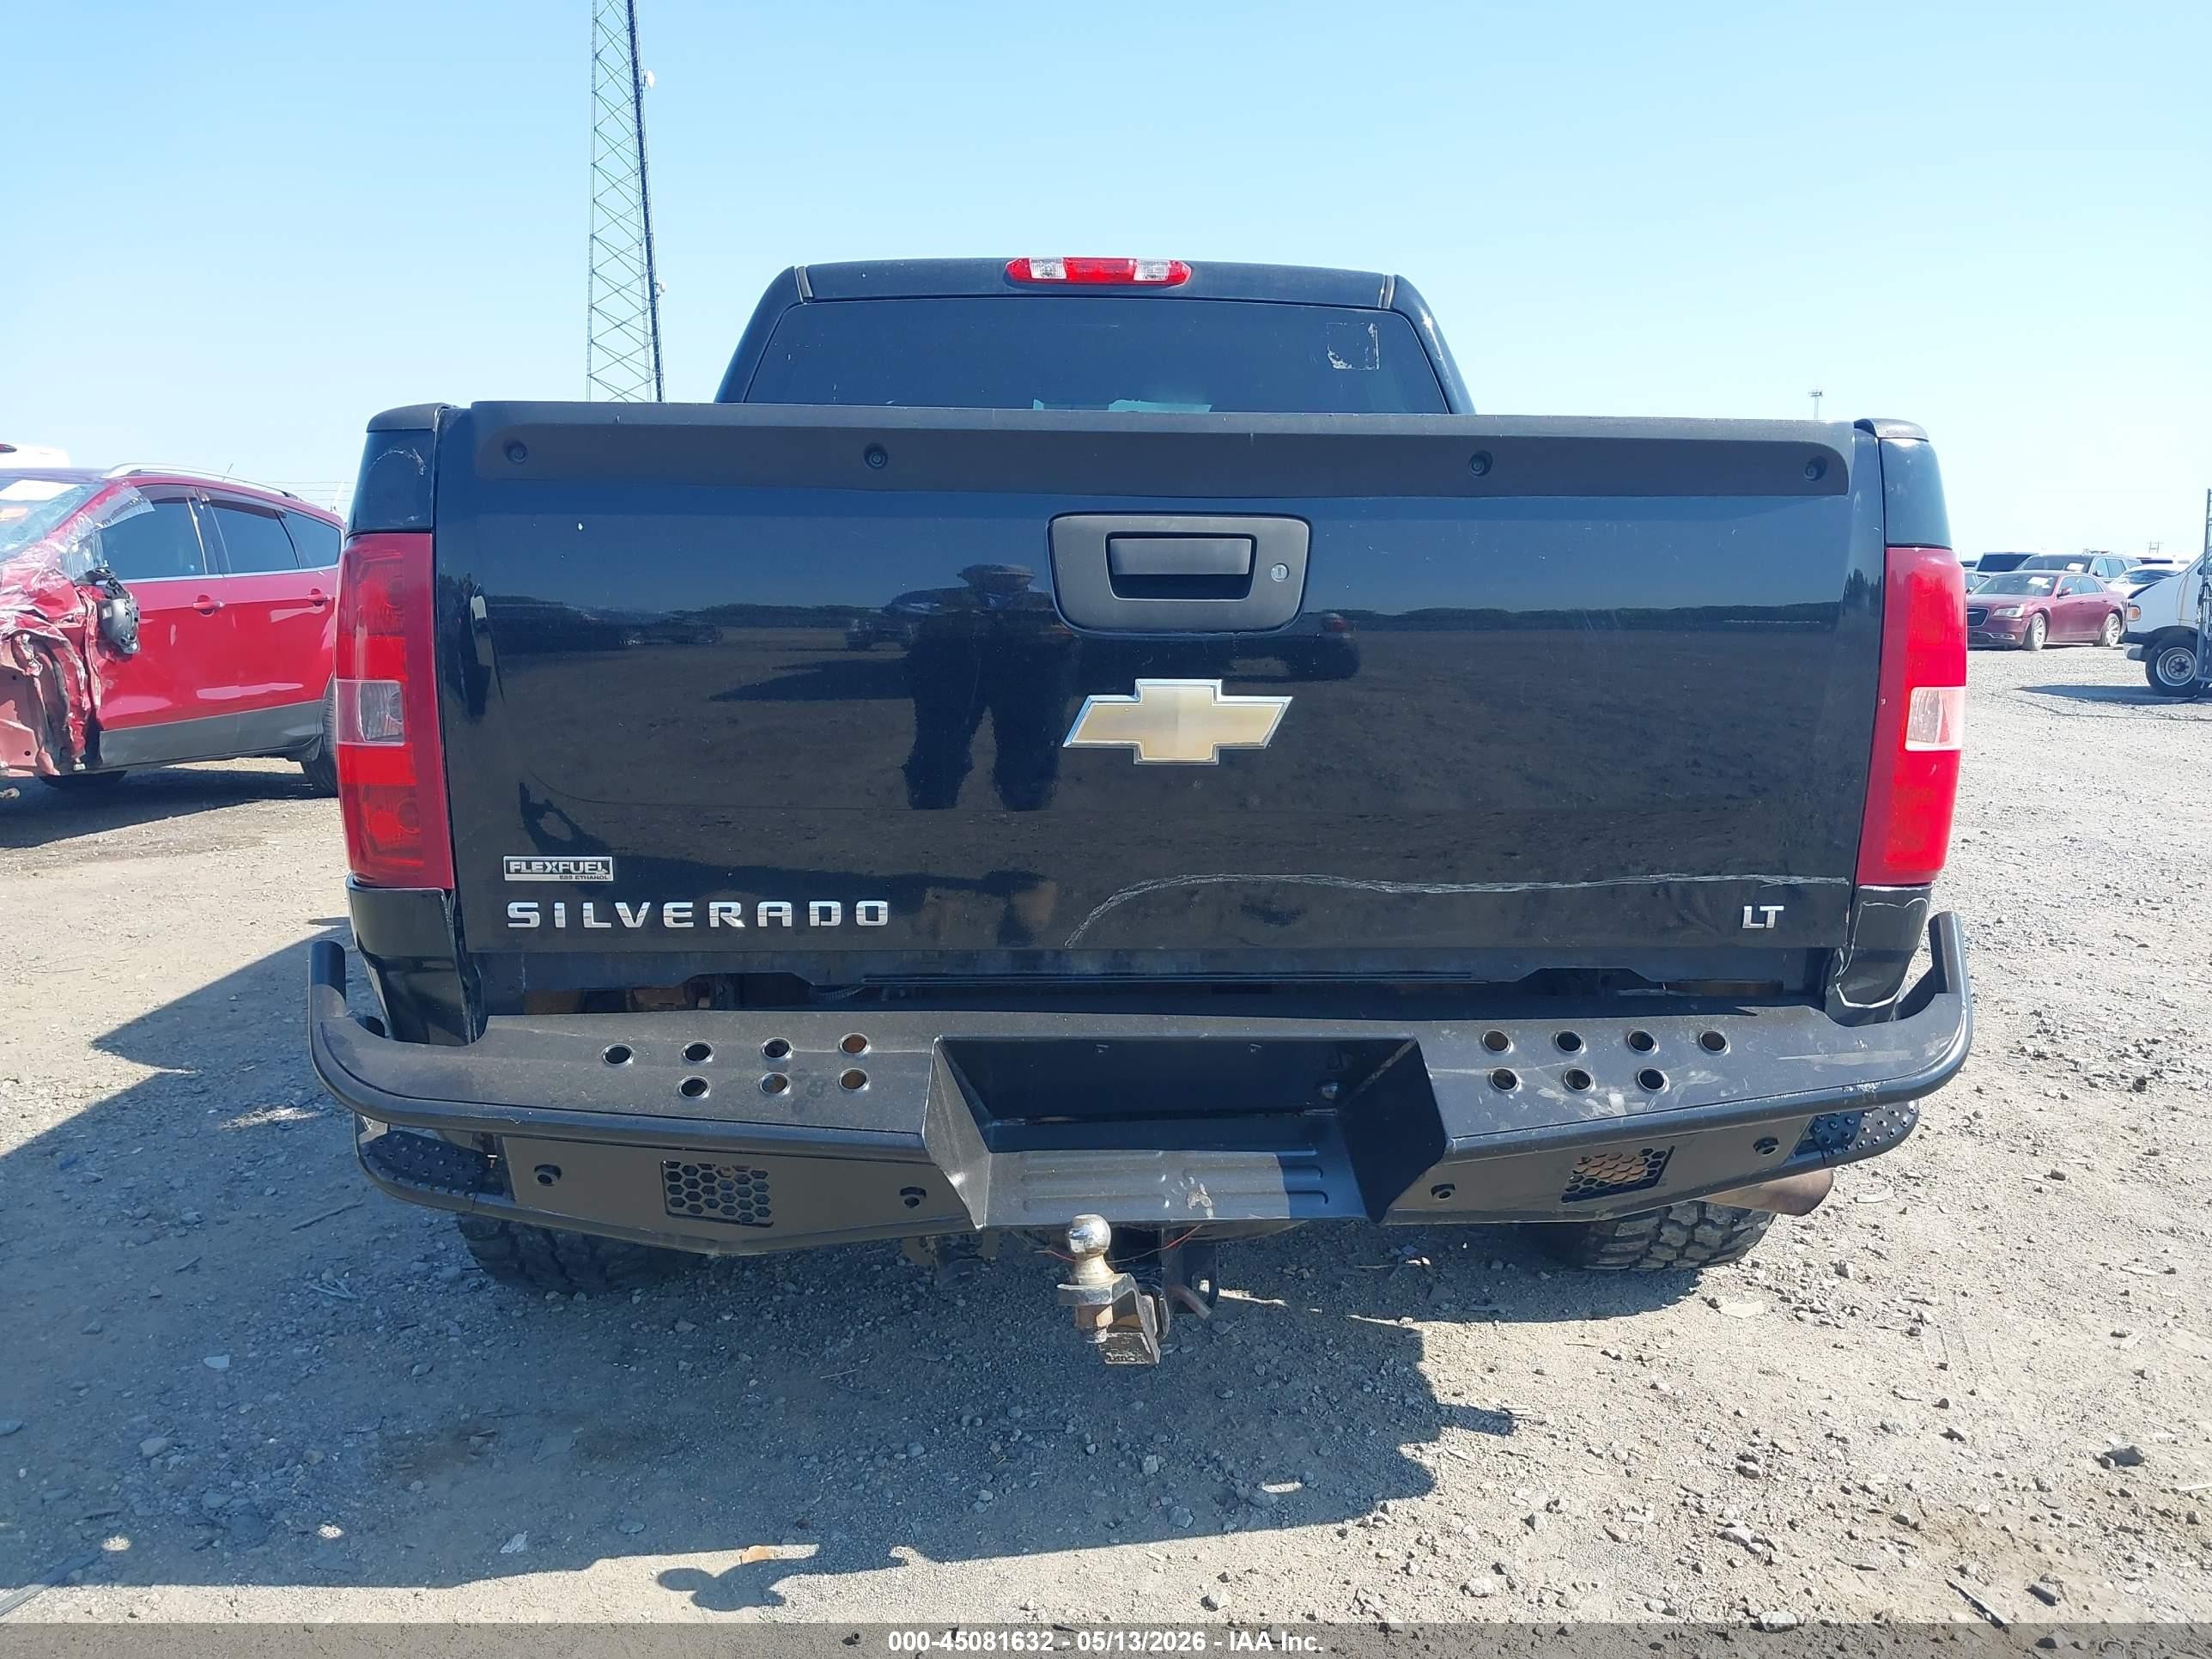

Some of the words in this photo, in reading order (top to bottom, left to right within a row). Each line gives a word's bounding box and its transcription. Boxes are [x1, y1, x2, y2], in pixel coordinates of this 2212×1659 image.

[509, 861, 608, 874] FLEXFUEL
[507, 900, 889, 928] SILVERADO
[1741, 905, 1785, 929] LT
